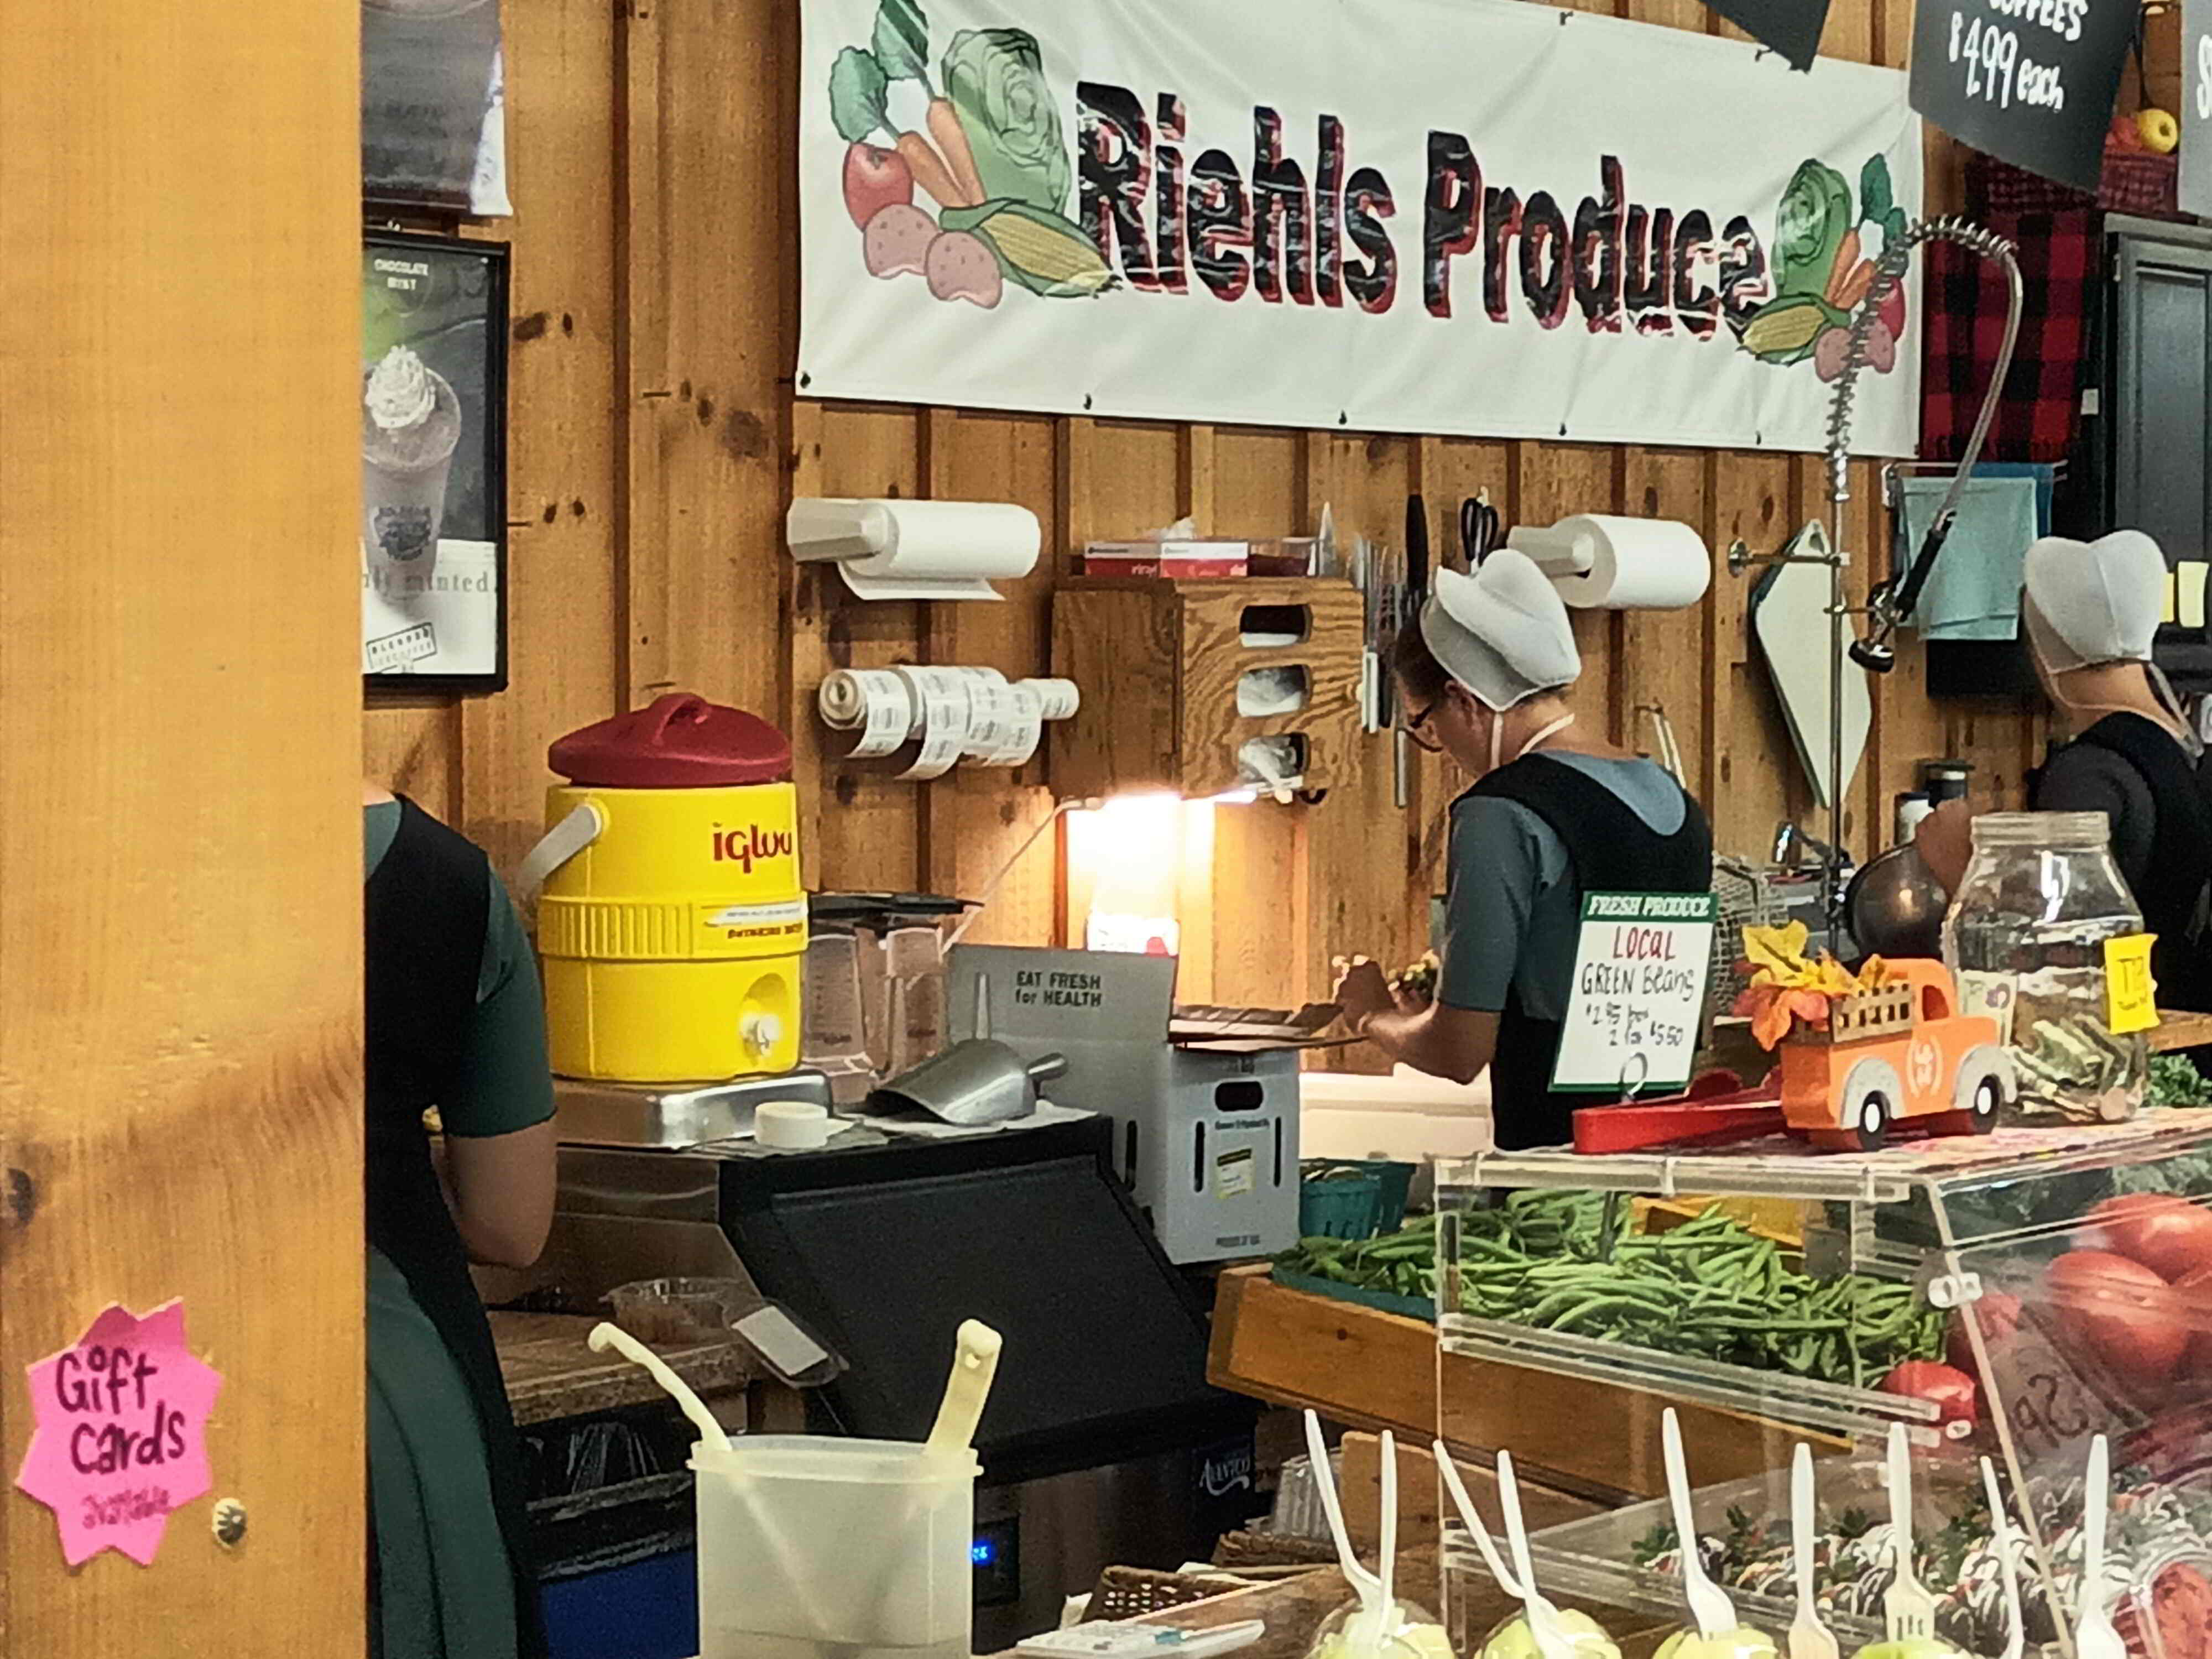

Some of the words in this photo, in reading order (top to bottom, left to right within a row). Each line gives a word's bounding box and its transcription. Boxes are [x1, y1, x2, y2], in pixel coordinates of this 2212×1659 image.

[1990, 0, 2089, 41] FEES
[2017, 58, 2064, 113] each
[1077, 81, 1398, 314] Riehls
[1423, 131, 1768, 344] Produce
[1015, 988, 1037, 1005] for
[1043, 989, 1102, 1007] HEALTH
[1016, 970, 1042, 987] EAT
[1049, 971, 1101, 990] FRESH
[1581, 962, 1636, 995] GREEN
[56, 1345, 158, 1414] Gift
[70, 1399, 185, 1475] Cards
